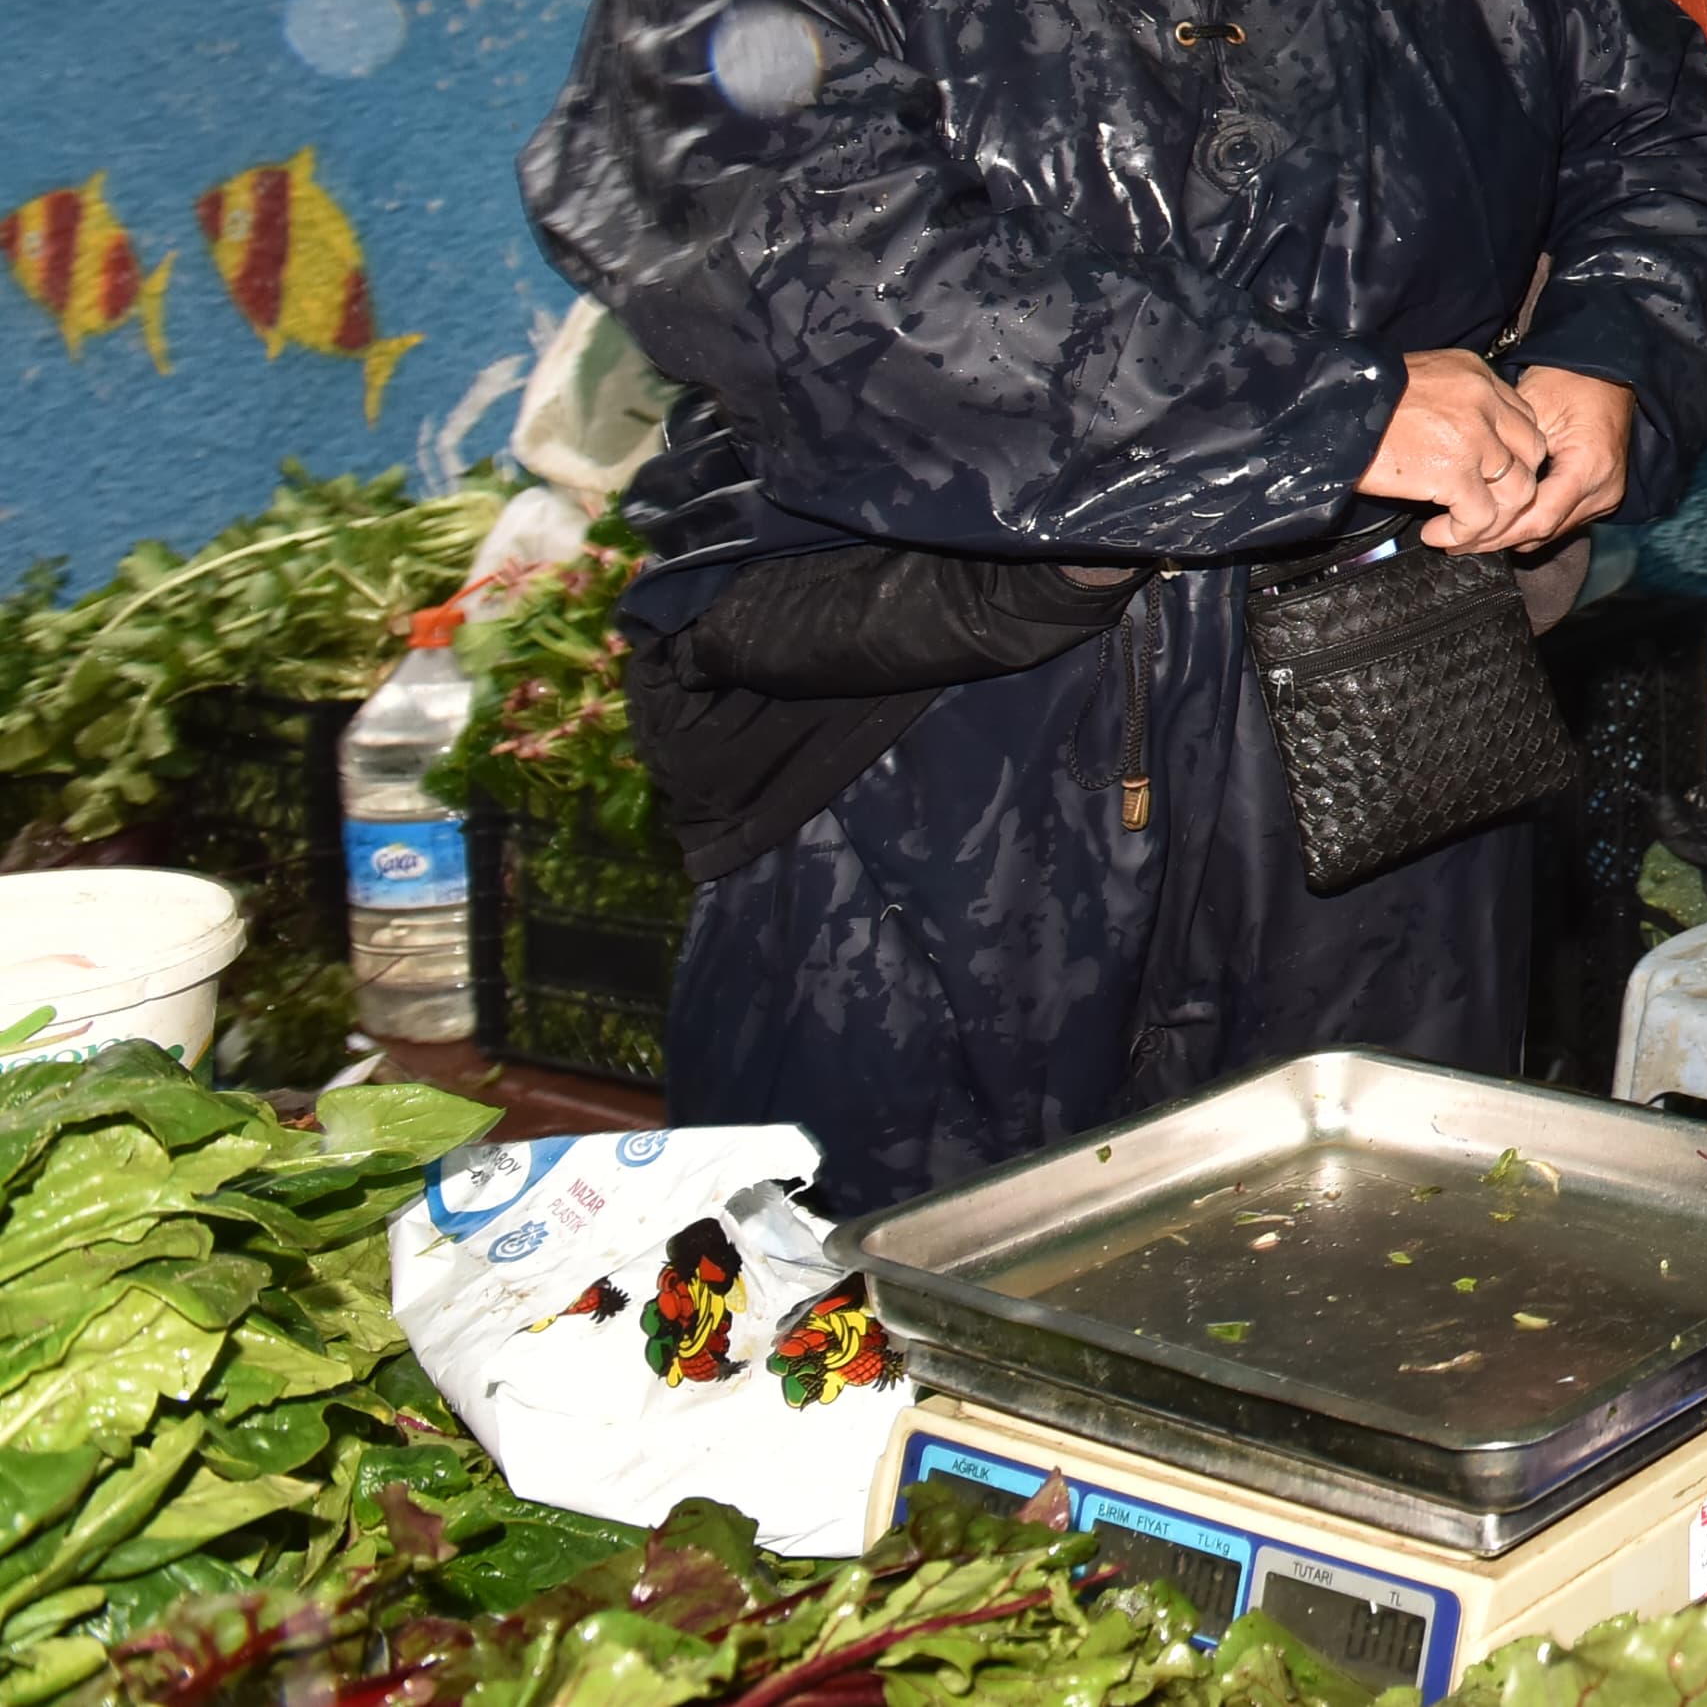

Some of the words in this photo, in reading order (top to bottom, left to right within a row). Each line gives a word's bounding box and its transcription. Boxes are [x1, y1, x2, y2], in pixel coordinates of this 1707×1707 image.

[567, 1178, 605, 1217] NAZAR
[952, 1458, 991, 1481] AĞIRLIK
[1098, 1502, 1131, 1524] BİRİM
[1136, 1515, 1171, 1536] FİYAT
[1197, 1533, 1231, 1556] TL/kg
[1293, 1561, 1335, 1587] TUTARI
[1389, 1591, 1402, 1607] TL
